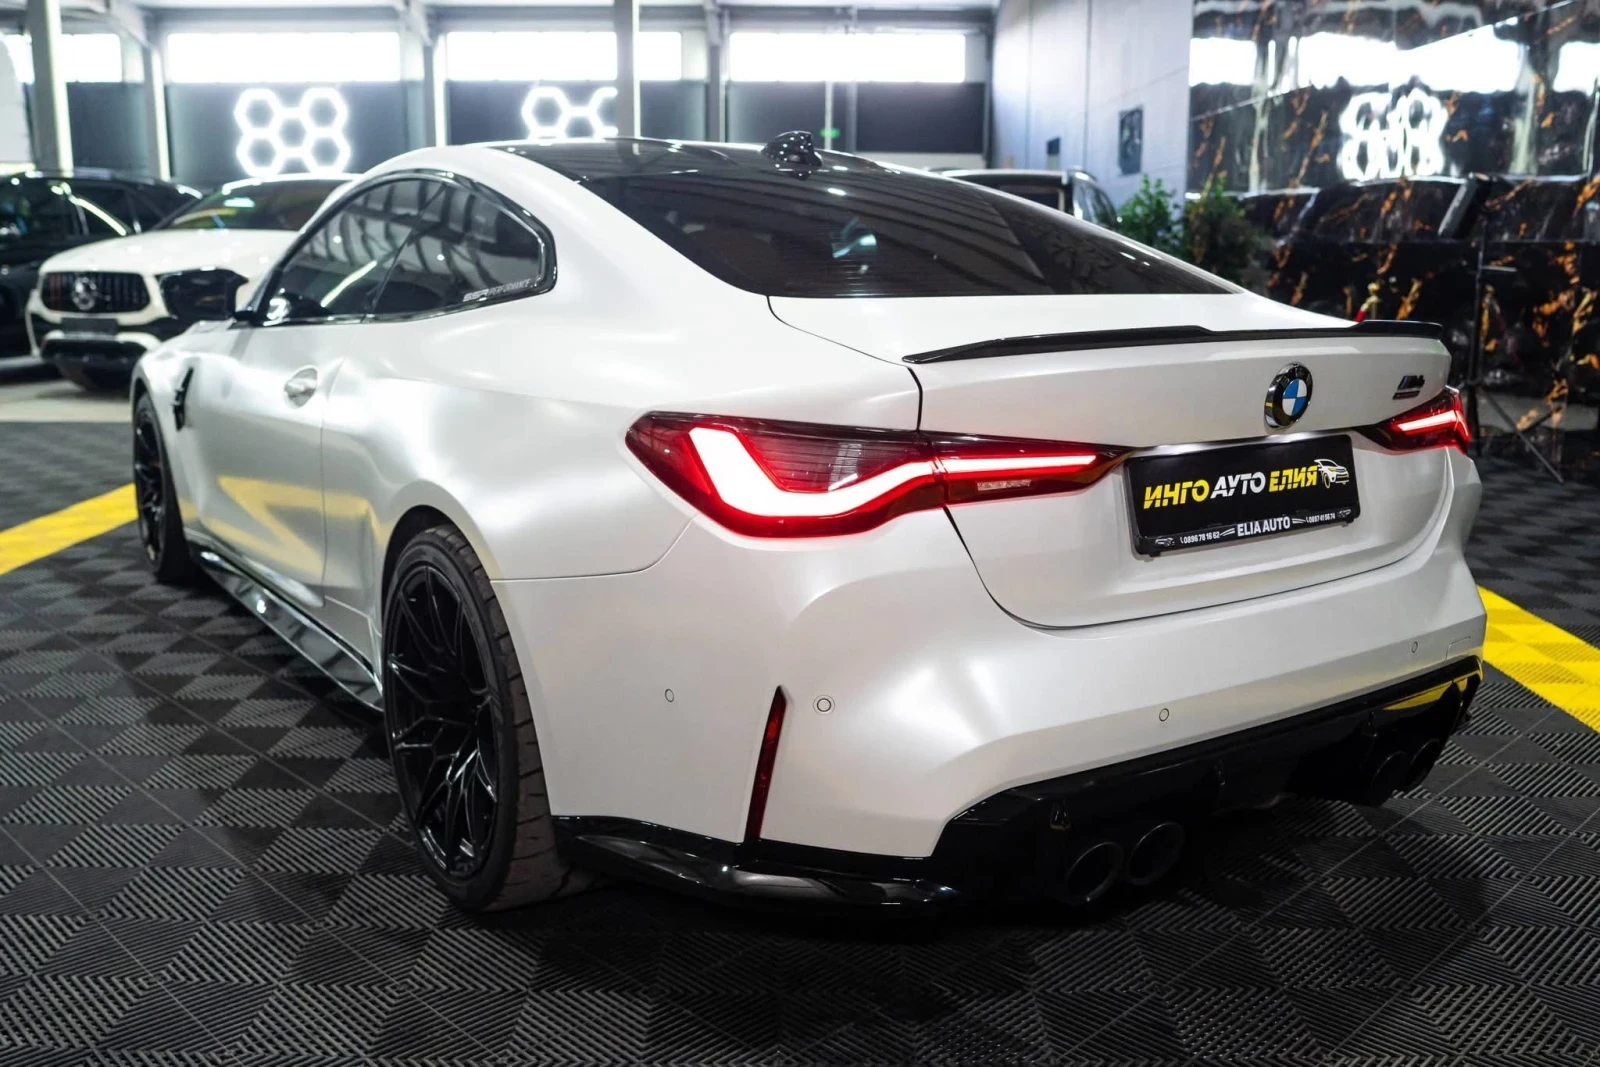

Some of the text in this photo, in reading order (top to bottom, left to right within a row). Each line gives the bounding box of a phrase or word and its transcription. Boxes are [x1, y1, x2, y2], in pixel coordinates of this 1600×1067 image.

[1143, 465, 1319, 510] ИНГО АУТО ЕЛИЯ
[1183, 535, 1199, 545] 0896
[1237, 521, 1262, 537] ELIA
[1262, 516, 1291, 533] AUTO
